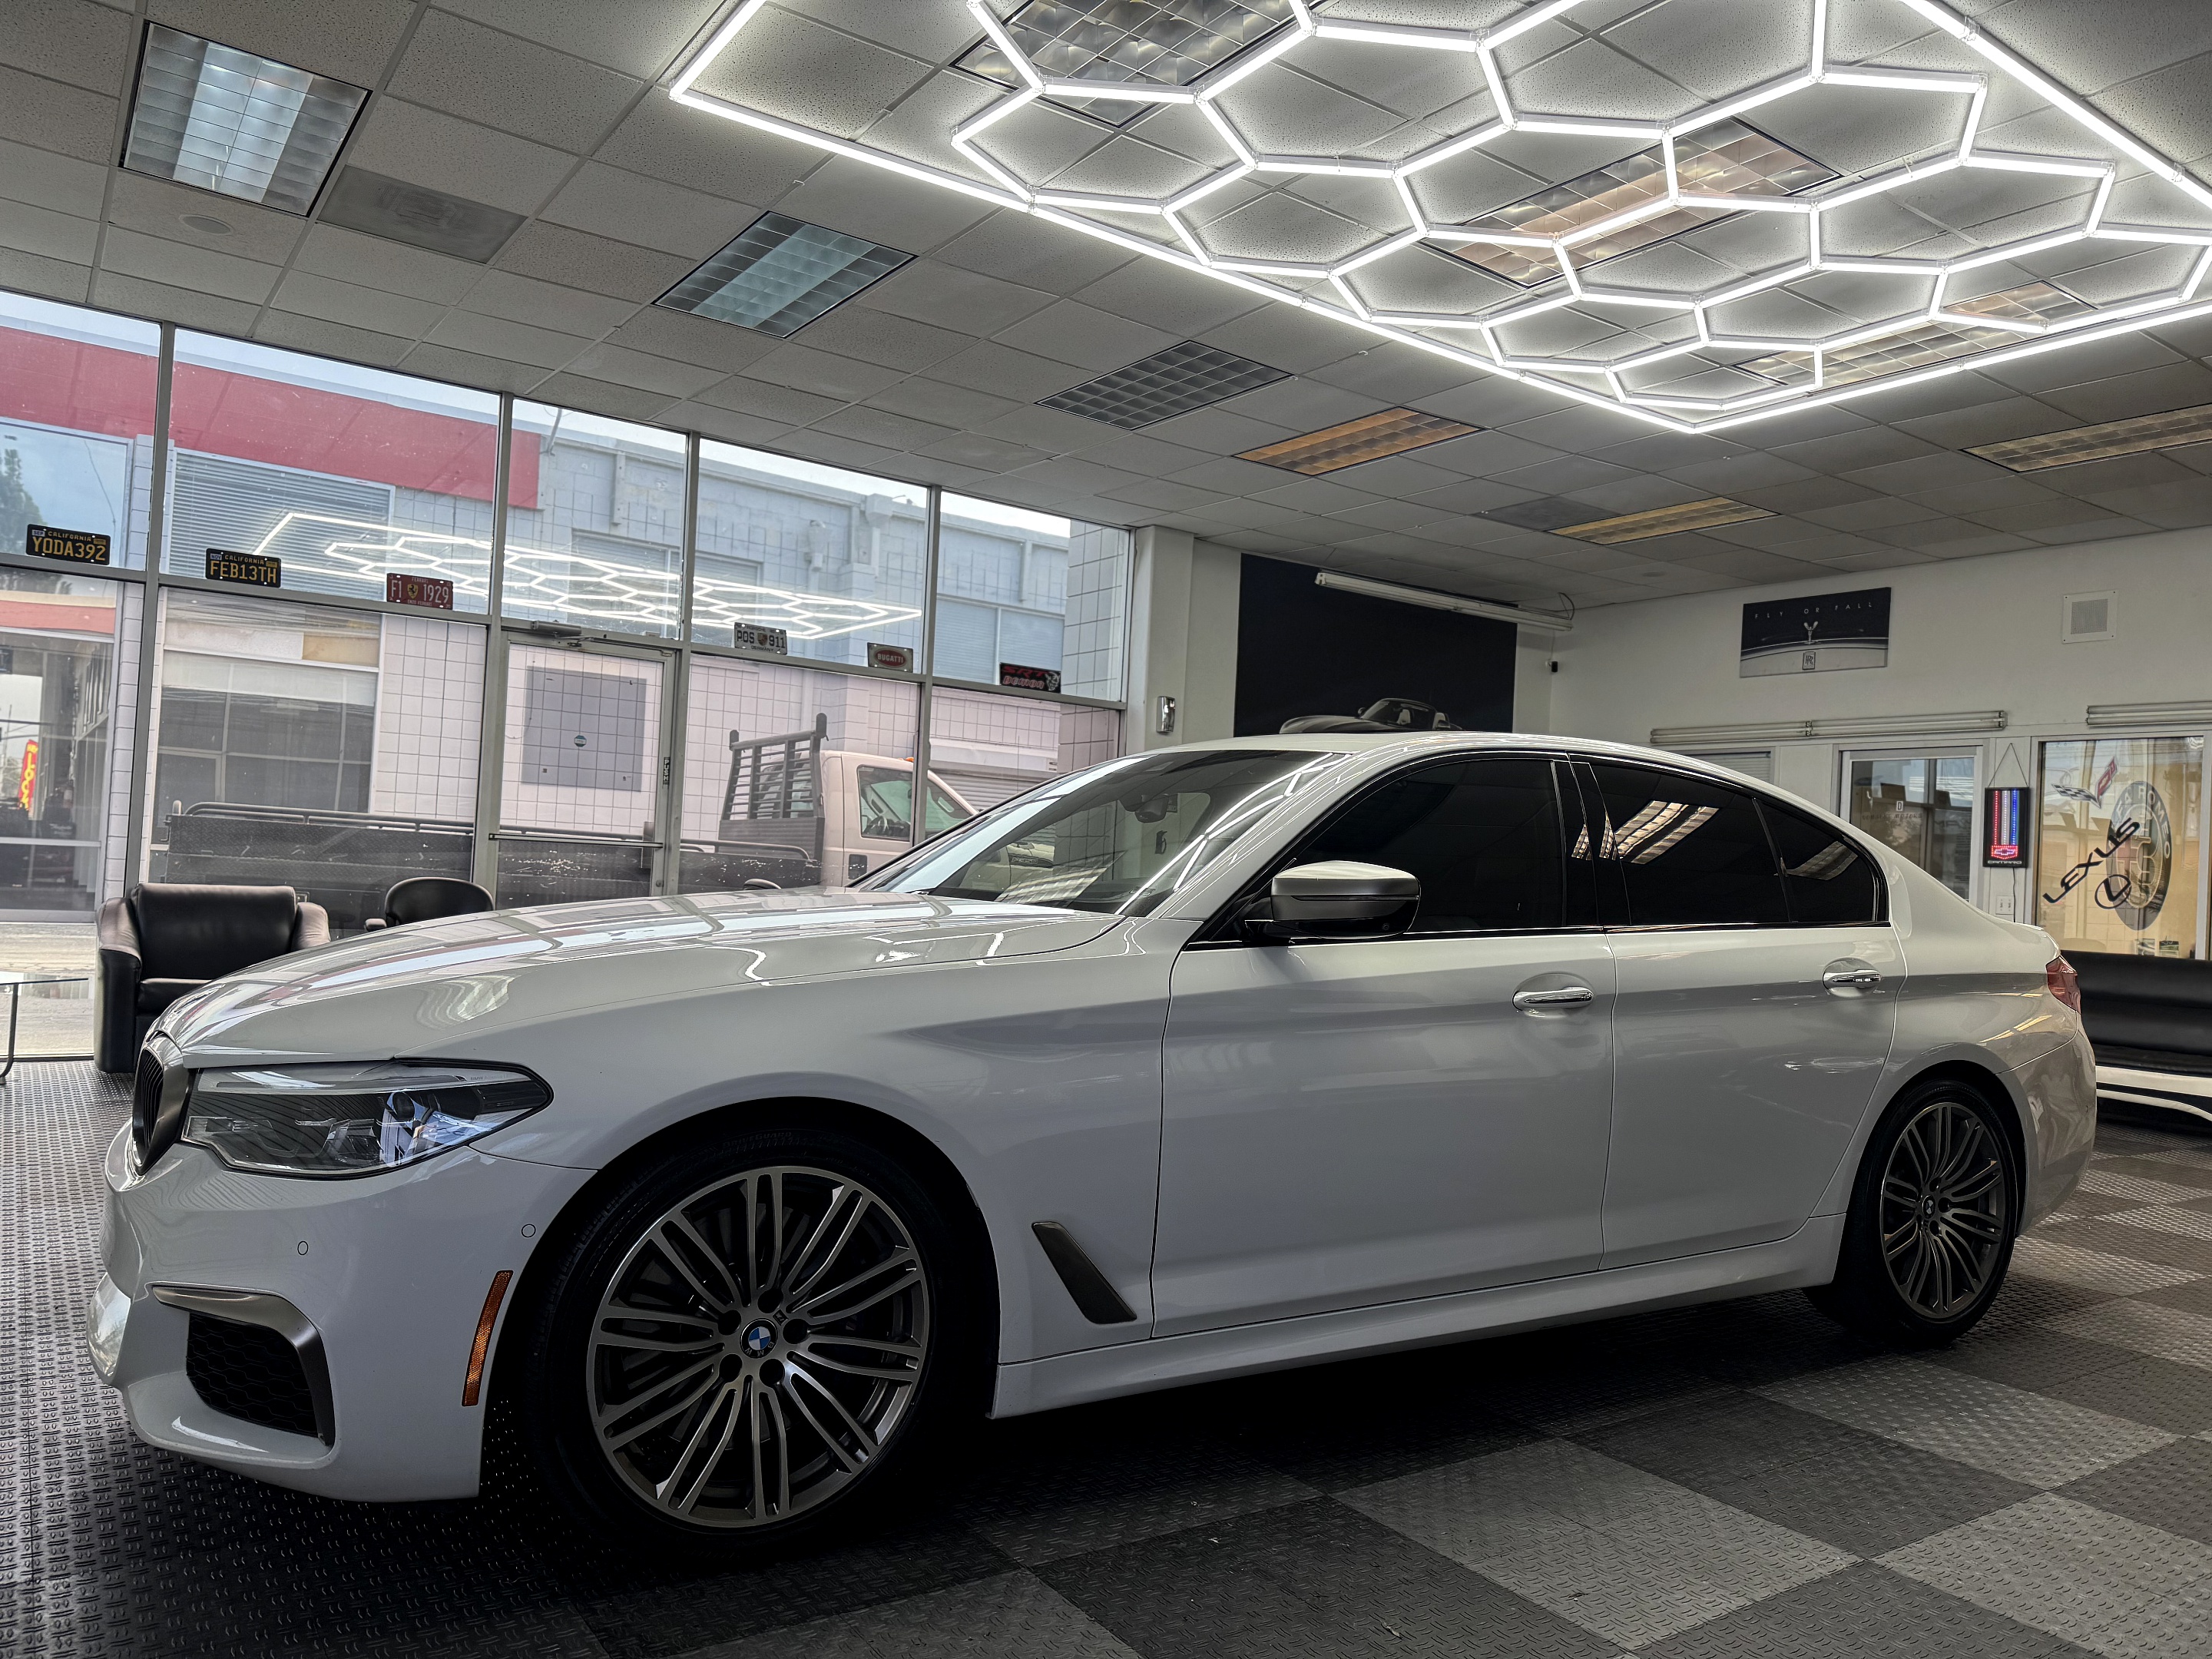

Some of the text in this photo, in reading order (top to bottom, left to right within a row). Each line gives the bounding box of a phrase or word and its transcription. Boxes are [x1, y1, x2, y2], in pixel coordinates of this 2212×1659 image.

[48, 531, 91, 541] CALIFORNIA
[32, 536, 106, 561] YODA392
[224, 555, 264, 565] CALIFORNIA
[210, 560, 276, 584] FEB13TH
[391, 580, 449, 604] F1 1929
[1835, 601, 1873, 611] FALL
[737, 630, 786, 648] POS 911
[877, 653, 904, 664] BUGATTI
[1002, 665, 1049, 679] SRT
[2137, 785, 2171, 859] ROMEO
[2042, 817, 2141, 903] LEXUS
